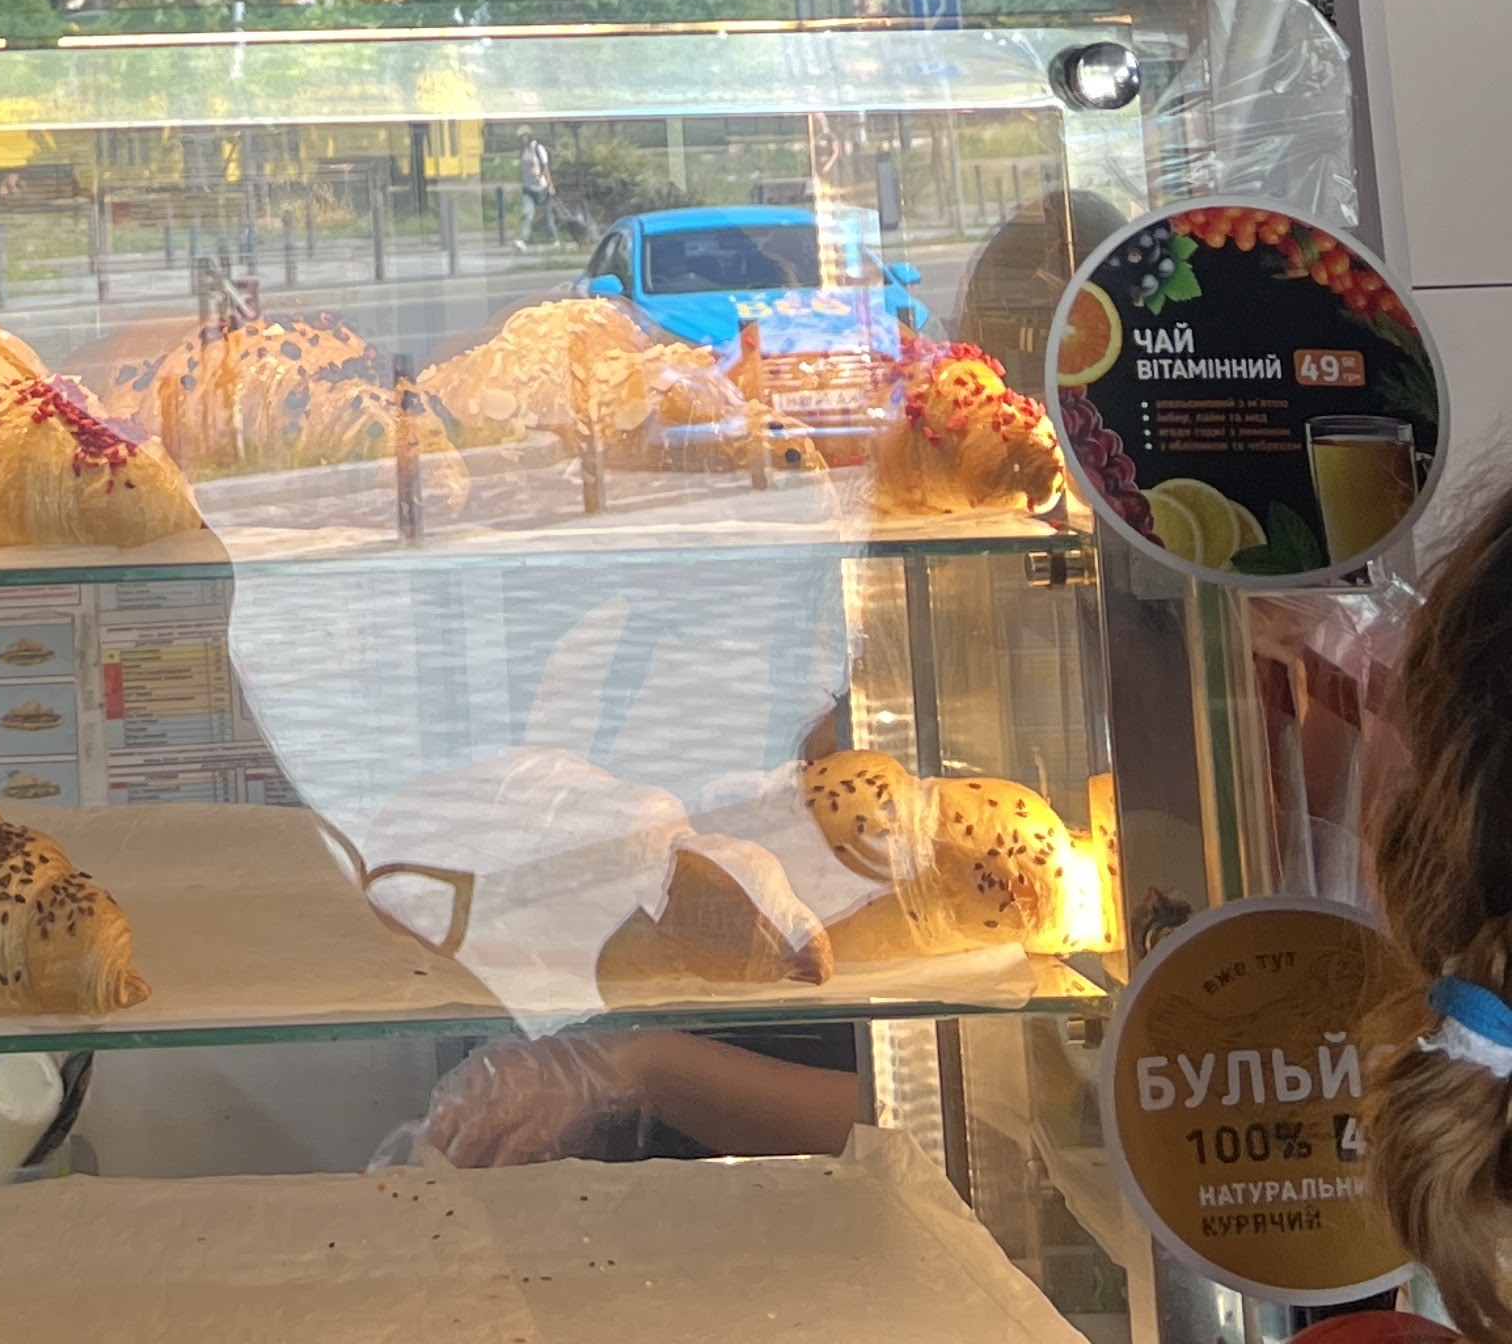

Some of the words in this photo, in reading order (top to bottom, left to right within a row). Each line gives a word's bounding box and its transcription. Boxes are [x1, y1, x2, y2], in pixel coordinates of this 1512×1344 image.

[1133, 322, 1195, 354] ЧАЙ
[1136, 353, 1283, 381] ВІТАМІННИЙ
[1301, 354, 1340, 382] 49
[1136, 1031, 1364, 1112] БУЛЬЙ
[1185, 1120, 1313, 1164] 100%
[1199, 1175, 1366, 1207] НАТУРАЛЬН
